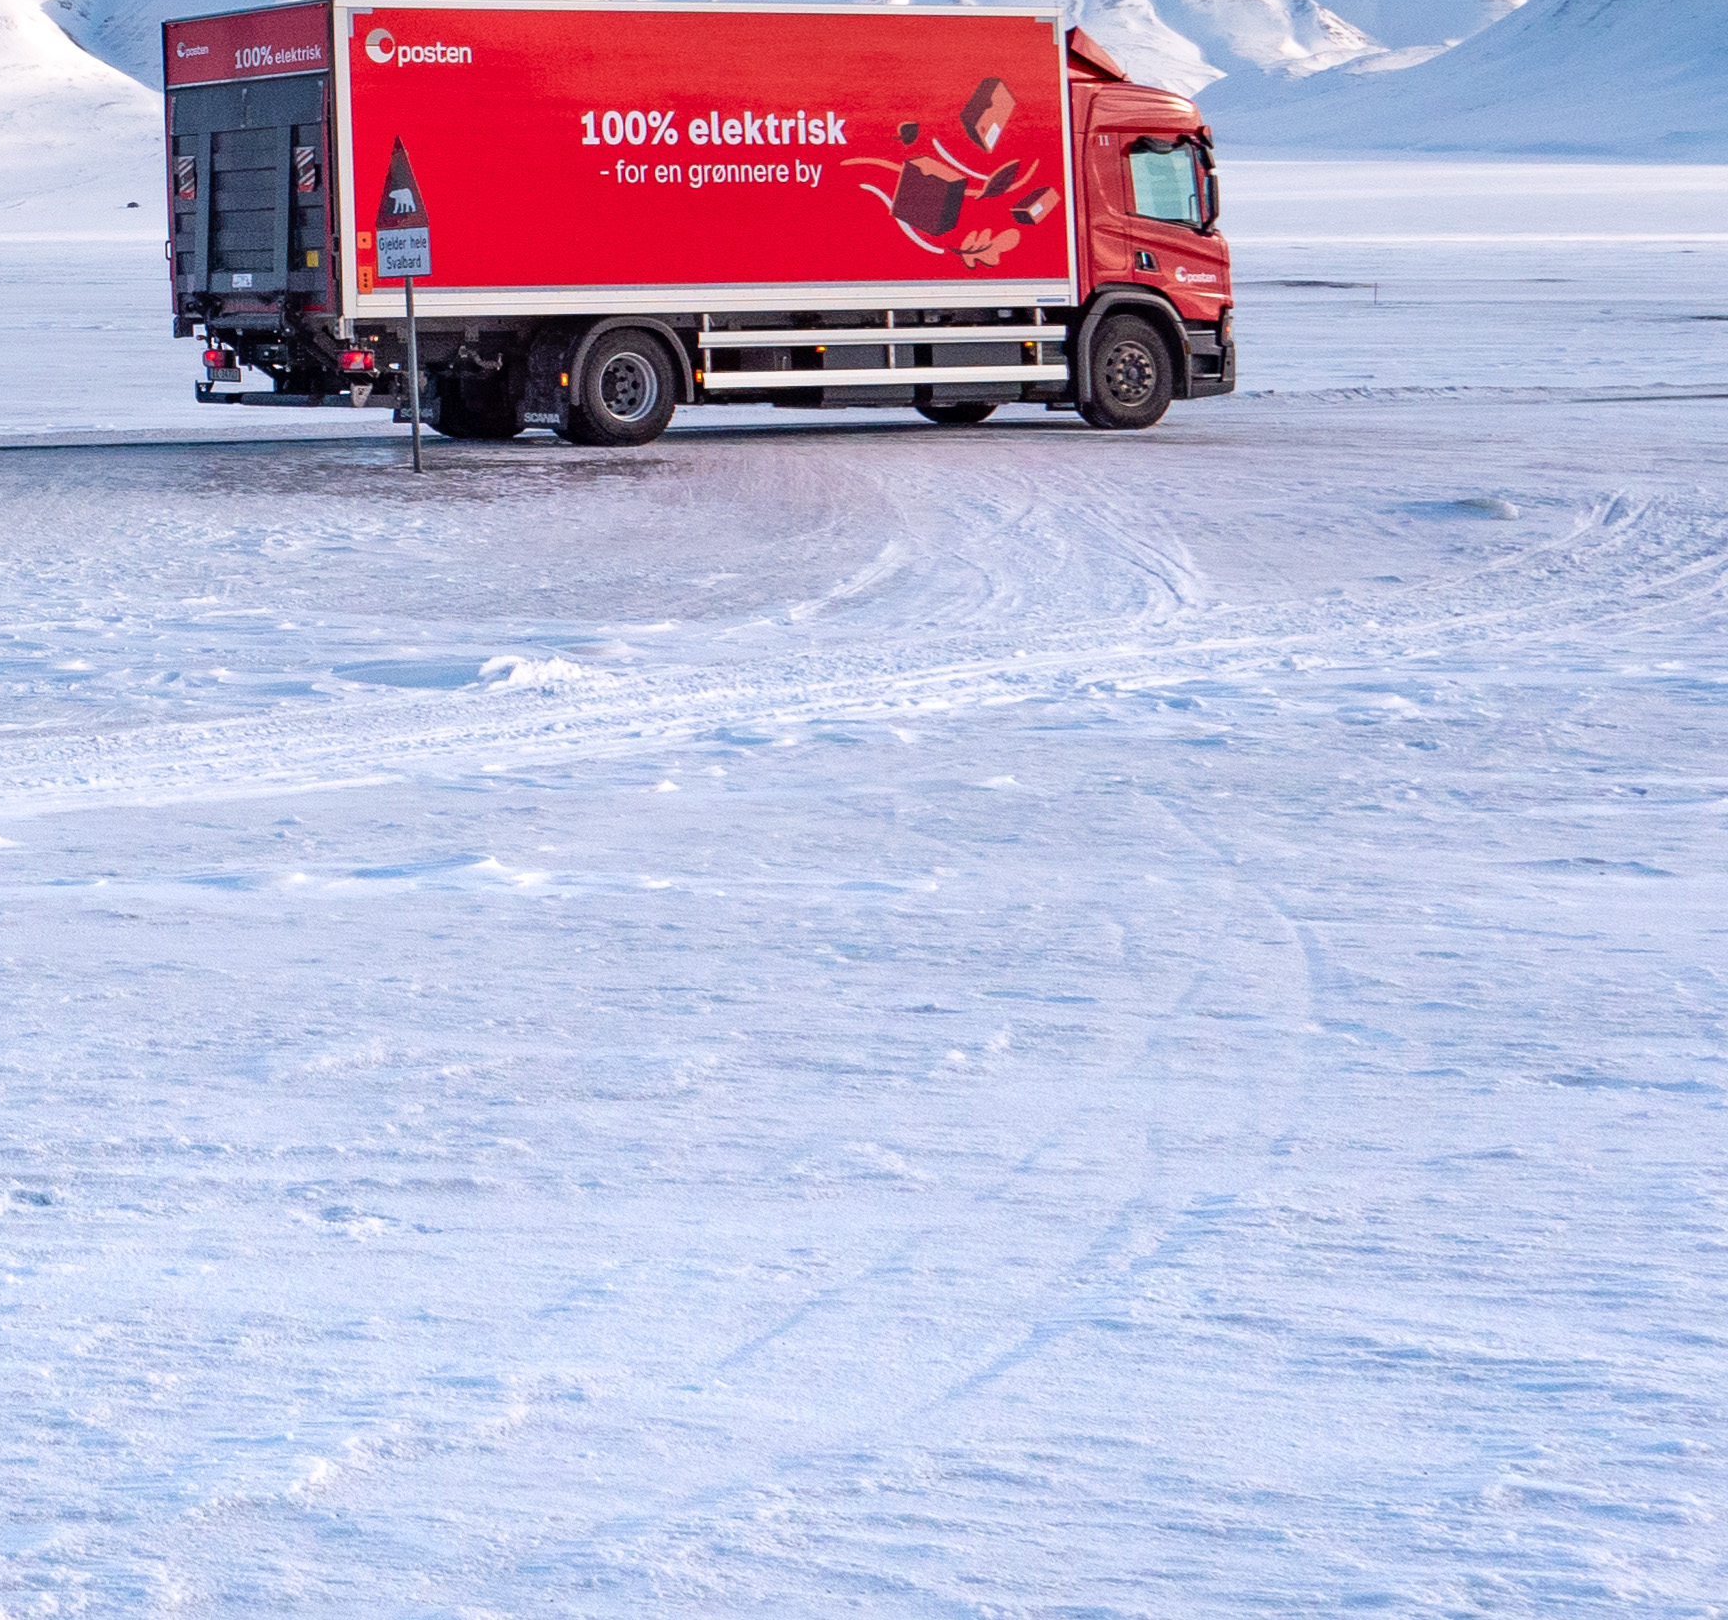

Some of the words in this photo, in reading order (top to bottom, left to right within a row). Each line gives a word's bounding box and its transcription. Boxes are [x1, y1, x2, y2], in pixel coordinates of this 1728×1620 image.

[185, 45, 209, 58] posten
[235, 45, 273, 69] 100%
[275, 44, 322, 64] elektrisk
[397, 41, 473, 68] posten
[581, 110, 679, 145] 100%
[688, 110, 847, 145] elektrisk
[615, 159, 648, 183] for
[654, 164, 682, 183] en
[688, 164, 789, 188] grønnere
[796, 159, 823, 187] by
[386, 254, 422, 269] Svalbard
[1187, 272, 1217, 284] posten
[524, 412, 561, 424] SCANIA
